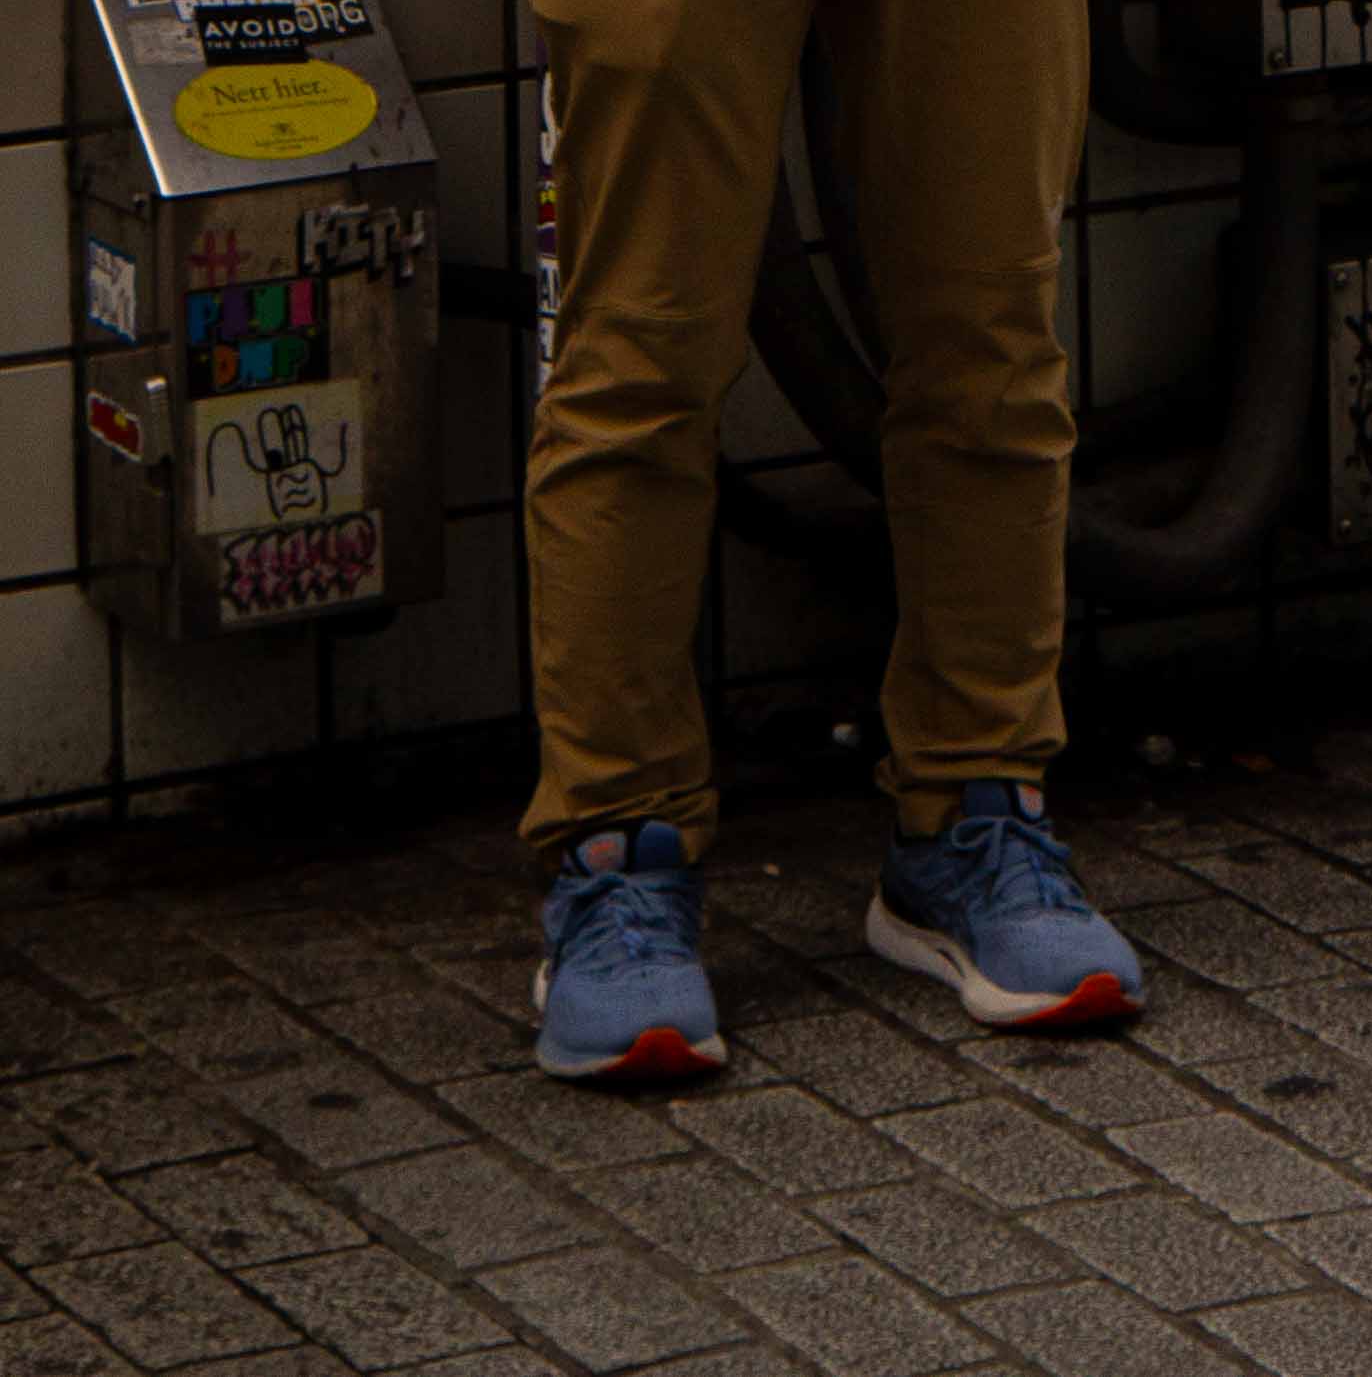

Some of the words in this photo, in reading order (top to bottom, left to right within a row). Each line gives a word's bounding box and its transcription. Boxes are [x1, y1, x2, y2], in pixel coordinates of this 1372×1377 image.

[203, 19, 297, 38] AVOID
[211, 84, 265, 106] Nett
[272, 78, 328, 97] hier.
